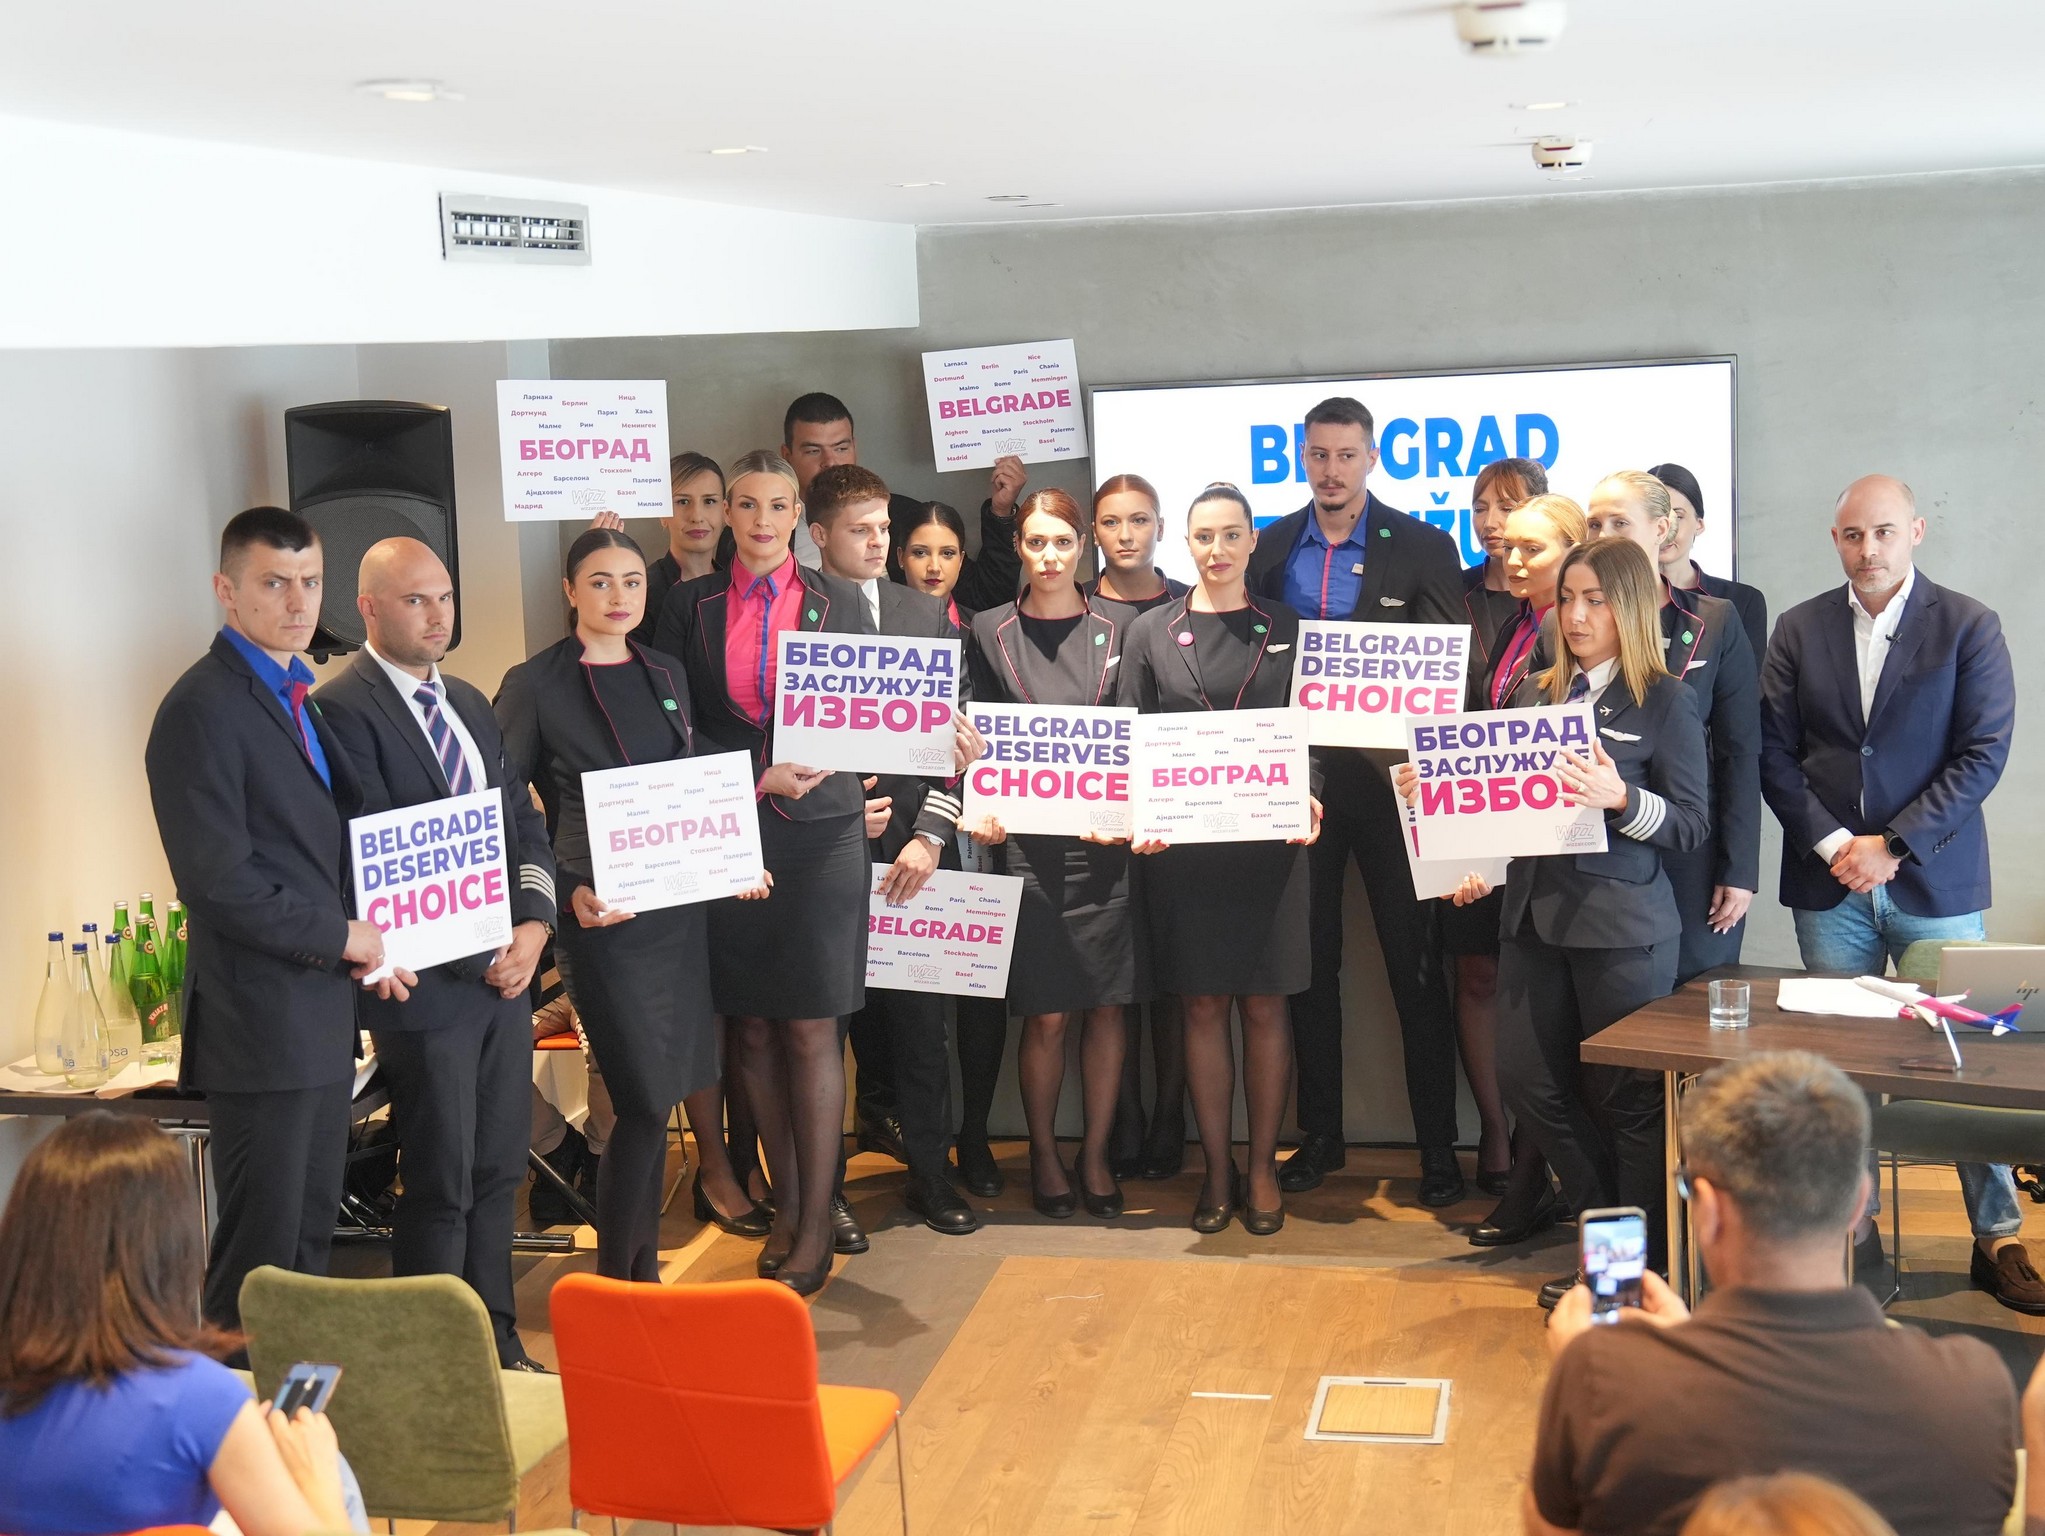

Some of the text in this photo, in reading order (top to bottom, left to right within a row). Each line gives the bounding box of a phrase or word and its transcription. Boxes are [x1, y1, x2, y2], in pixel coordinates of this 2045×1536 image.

[1032, 375, 1067, 383] Memmingen
[939, 389, 1071, 419] BELGRADE
[945, 429, 968, 437] Alghero
[982, 426, 1011, 434] Barcelona
[1023, 418, 1054, 426] Stockholm
[520, 439, 651, 462] БЕОГРАД
[950, 441, 981, 449] Eindhoven
[1250, 413, 1559, 484] BGRAD
[1304, 632, 1463, 656] BELGRADE
[785, 642, 953, 677] БЕОГРАД
[1301, 656, 1460, 681] DESERVES
[784, 673, 952, 698] ЗАСЛУЖУЈЕ
[1299, 682, 1458, 714] CHOICE
[783, 694, 951, 733] ИЗБОР
[974, 715, 1131, 740] BELGRADE
[1414, 715, 1589, 751] БЕОГРАД
[1152, 763, 1288, 787] БЕОГРАД
[1418, 749, 1589, 778] ЗАСЛУЖУ
[648, 781, 674, 790] Берлин
[684, 787, 704, 795] Париз
[973, 767, 1128, 801] CHOICE
[627, 809, 650, 817] Малме
[360, 805, 498, 859] BELGRADE
[609, 813, 740, 852] БЕОГРАД
[363, 835, 500, 891] DESERVES
[608, 861, 633, 870] Алгеро
[645, 859, 680, 869] Барселона
[724, 851, 752, 860] Палермо
[709, 867, 728, 875] Базел
[730, 875, 755, 884] Милано
[367, 868, 504, 934] CHOICE
[608, 895, 636, 904] Мадрид
[966, 909, 1006, 917] Memmingen
